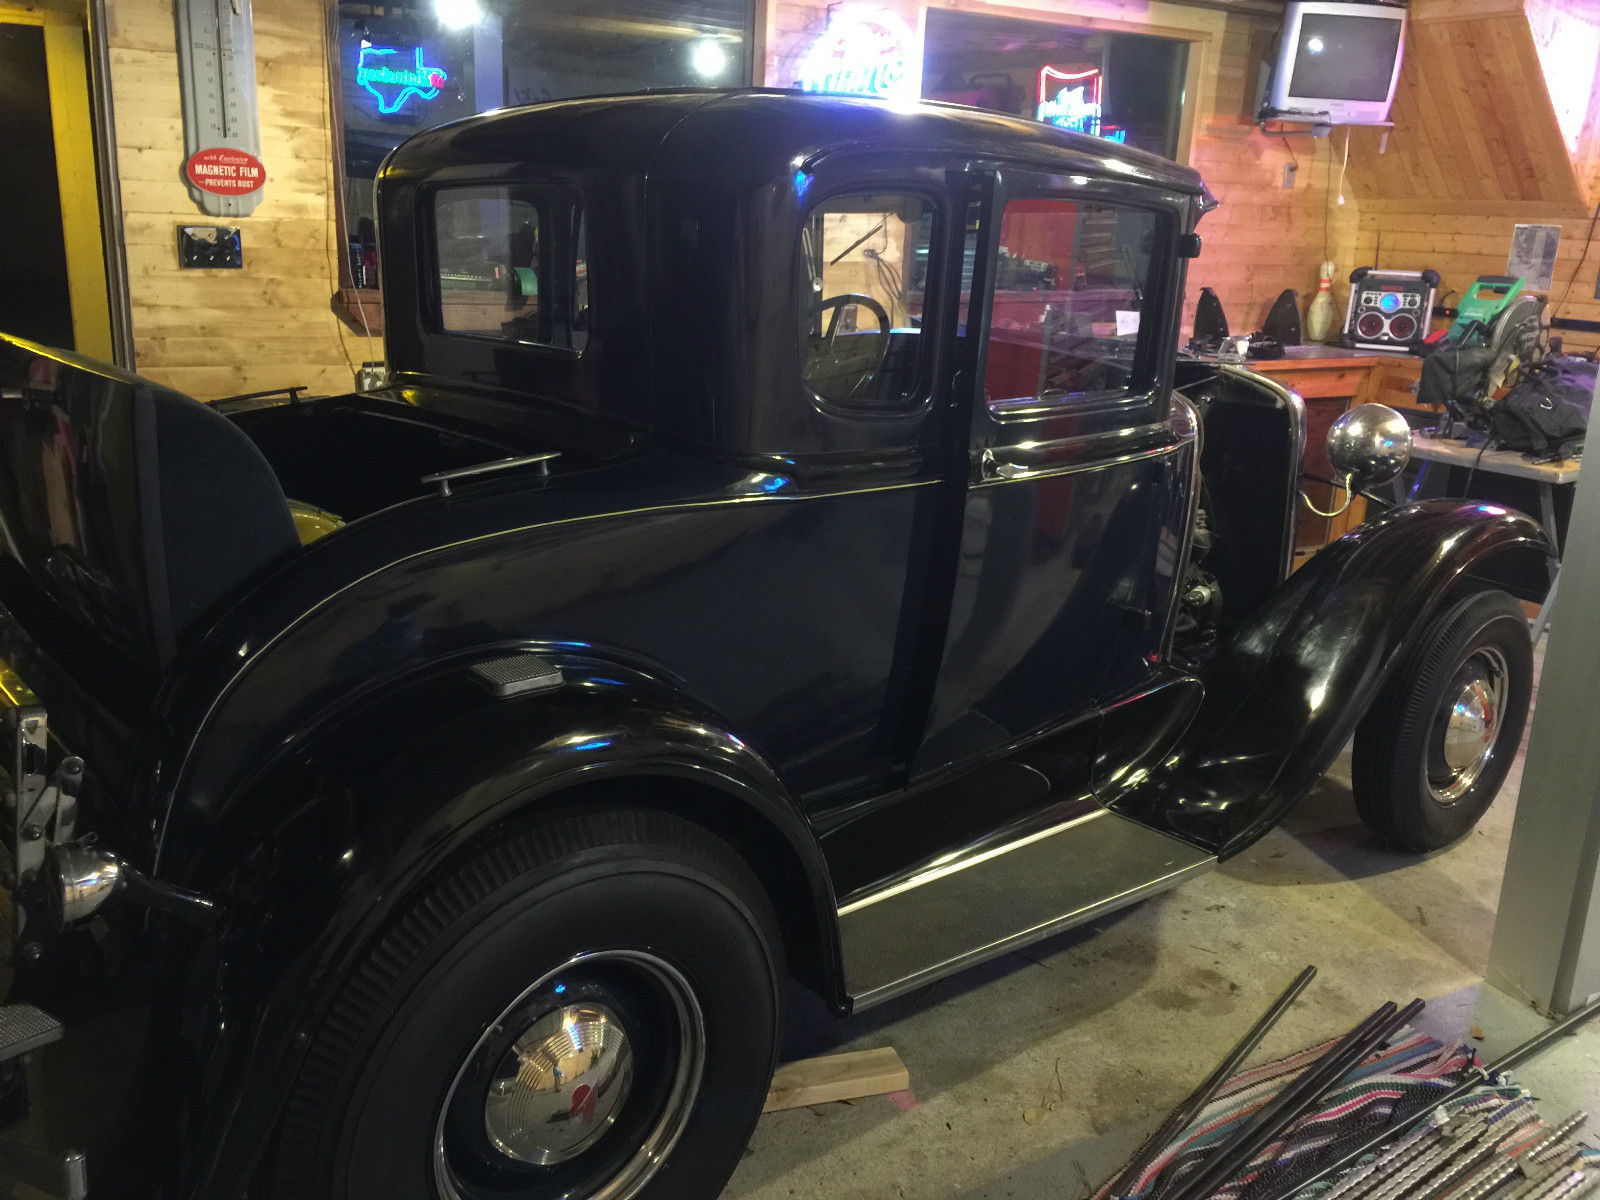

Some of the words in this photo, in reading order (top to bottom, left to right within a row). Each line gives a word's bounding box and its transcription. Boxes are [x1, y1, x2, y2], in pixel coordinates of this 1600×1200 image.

[194, 164, 237, 177] MAGNETIC
[239, 166, 259, 178] FILM
[237, 179, 254, 188] RUST
